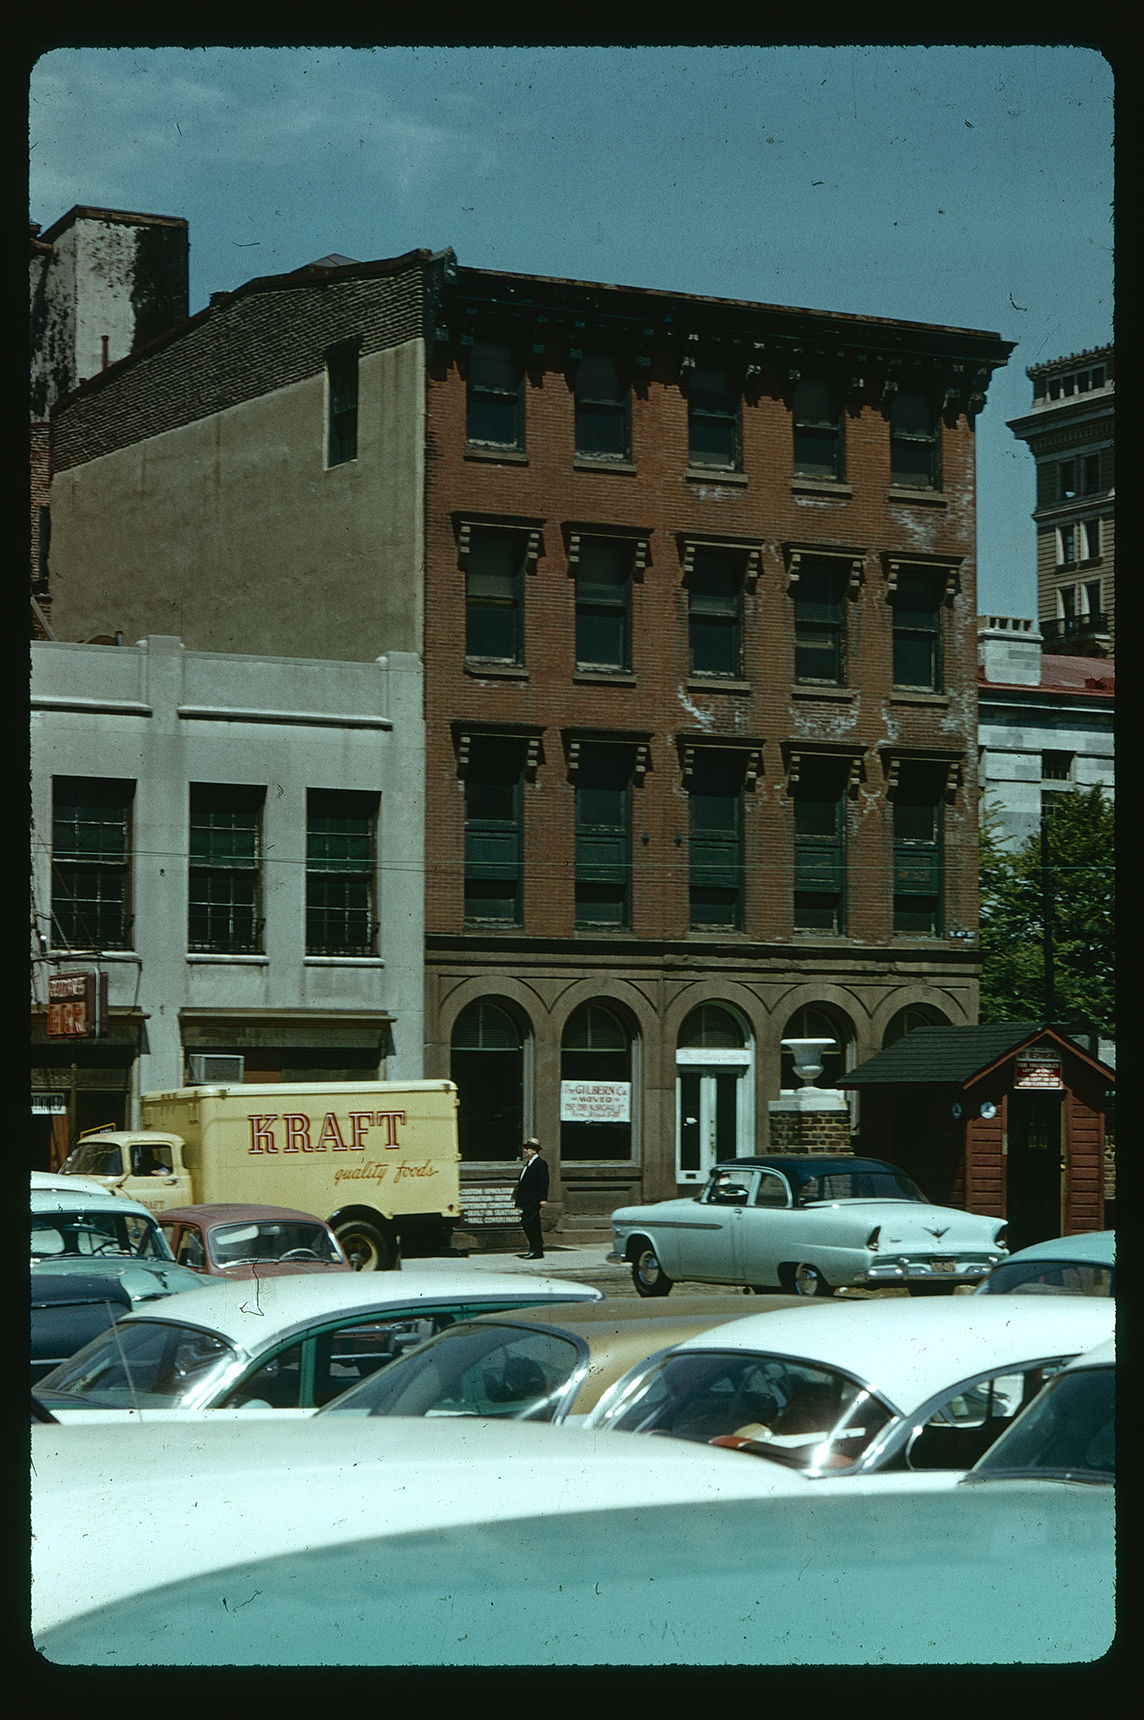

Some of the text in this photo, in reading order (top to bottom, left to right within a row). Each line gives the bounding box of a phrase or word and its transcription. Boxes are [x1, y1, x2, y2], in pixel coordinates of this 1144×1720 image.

[575, 1084, 615, 1095] GILBERN
[248, 1110, 406, 1155] KRAFT
[334, 1159, 439, 1186] quality foods
[141, 1200, 165, 1210] RAFT
